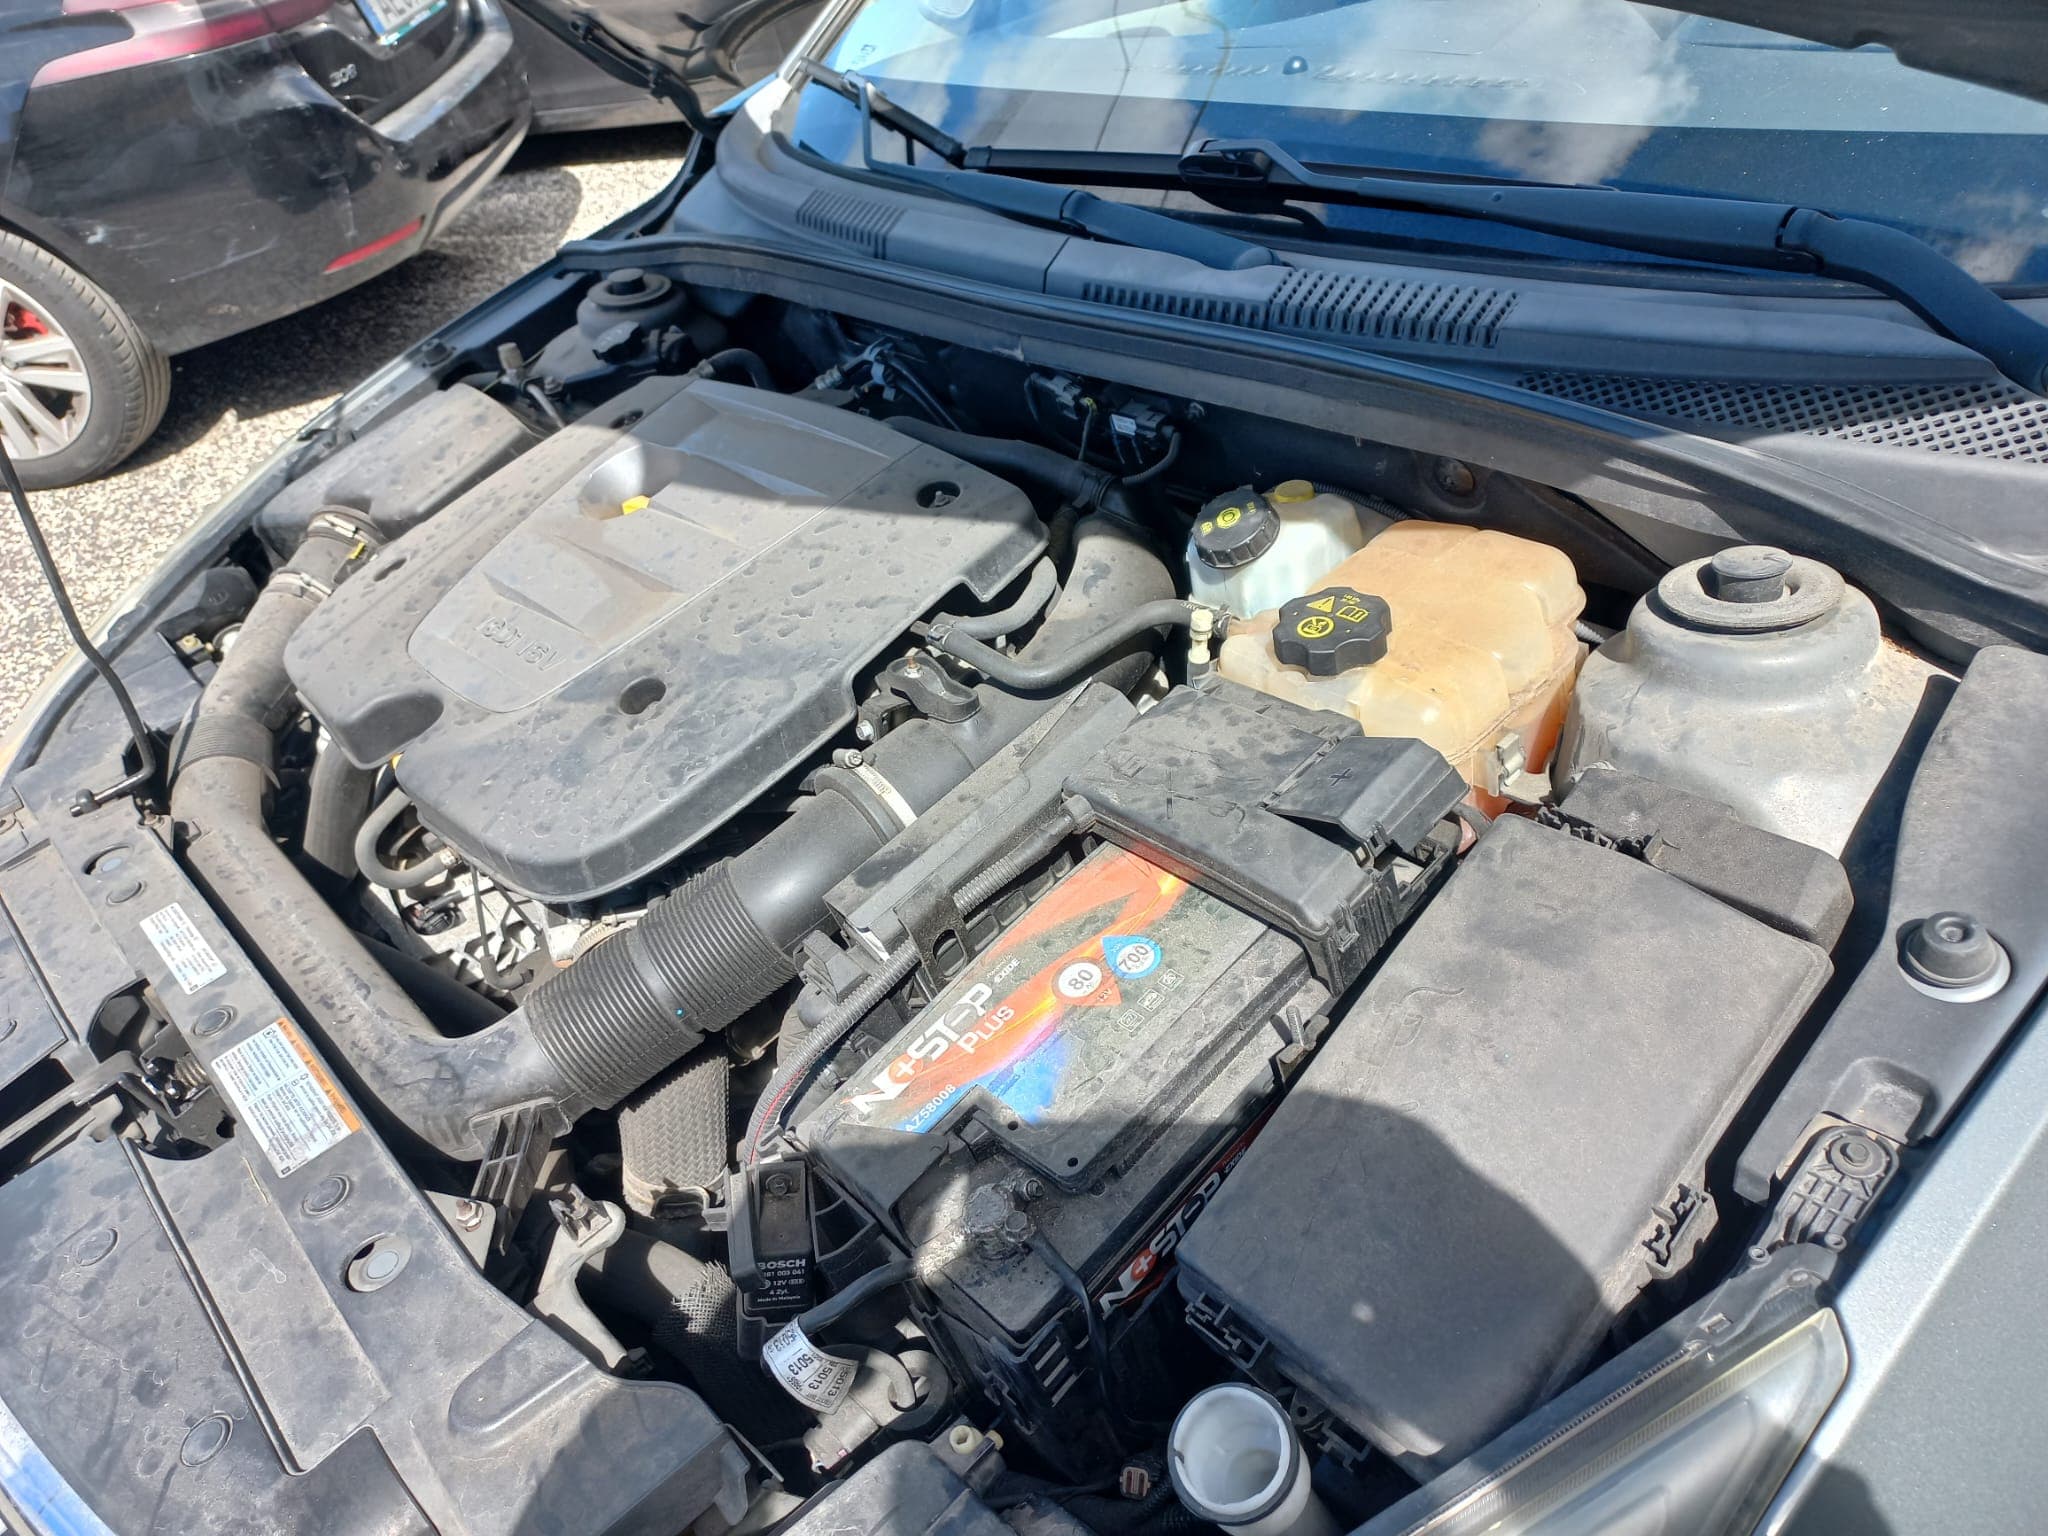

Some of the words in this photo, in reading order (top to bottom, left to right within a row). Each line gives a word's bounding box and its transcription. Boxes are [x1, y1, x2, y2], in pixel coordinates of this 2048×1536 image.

[1118, 945, 1149, 971] 700
[1068, 969, 1094, 991] 80
[957, 1005, 1015, 1055] PLUS
[757, 1258, 806, 1270] BOSCH
[788, 1353, 814, 1375] 5013
[808, 1367, 833, 1390] 5013
[827, 1371, 849, 1397] 5013
